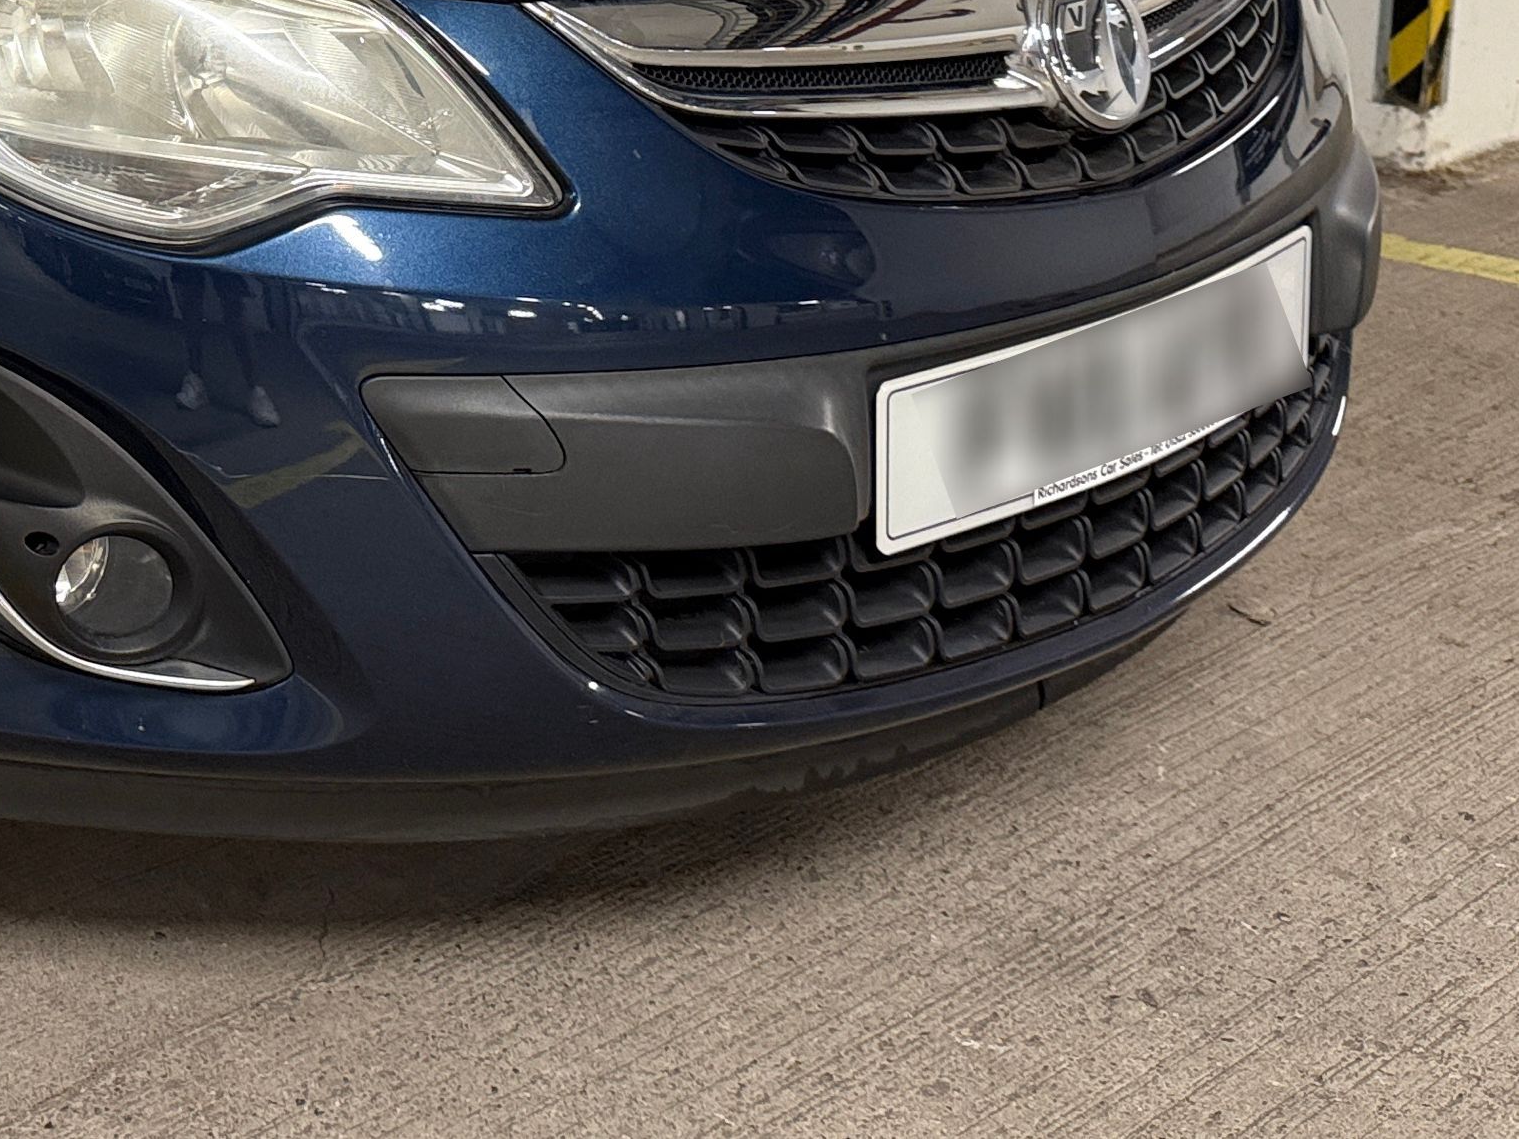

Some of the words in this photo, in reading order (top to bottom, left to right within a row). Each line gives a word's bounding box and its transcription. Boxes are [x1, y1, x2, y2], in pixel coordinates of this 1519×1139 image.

[1067, 5, 1083, 27] V
[1038, 470, 1098, 500] Richardsons
[1100, 463, 1117, 477] Car
